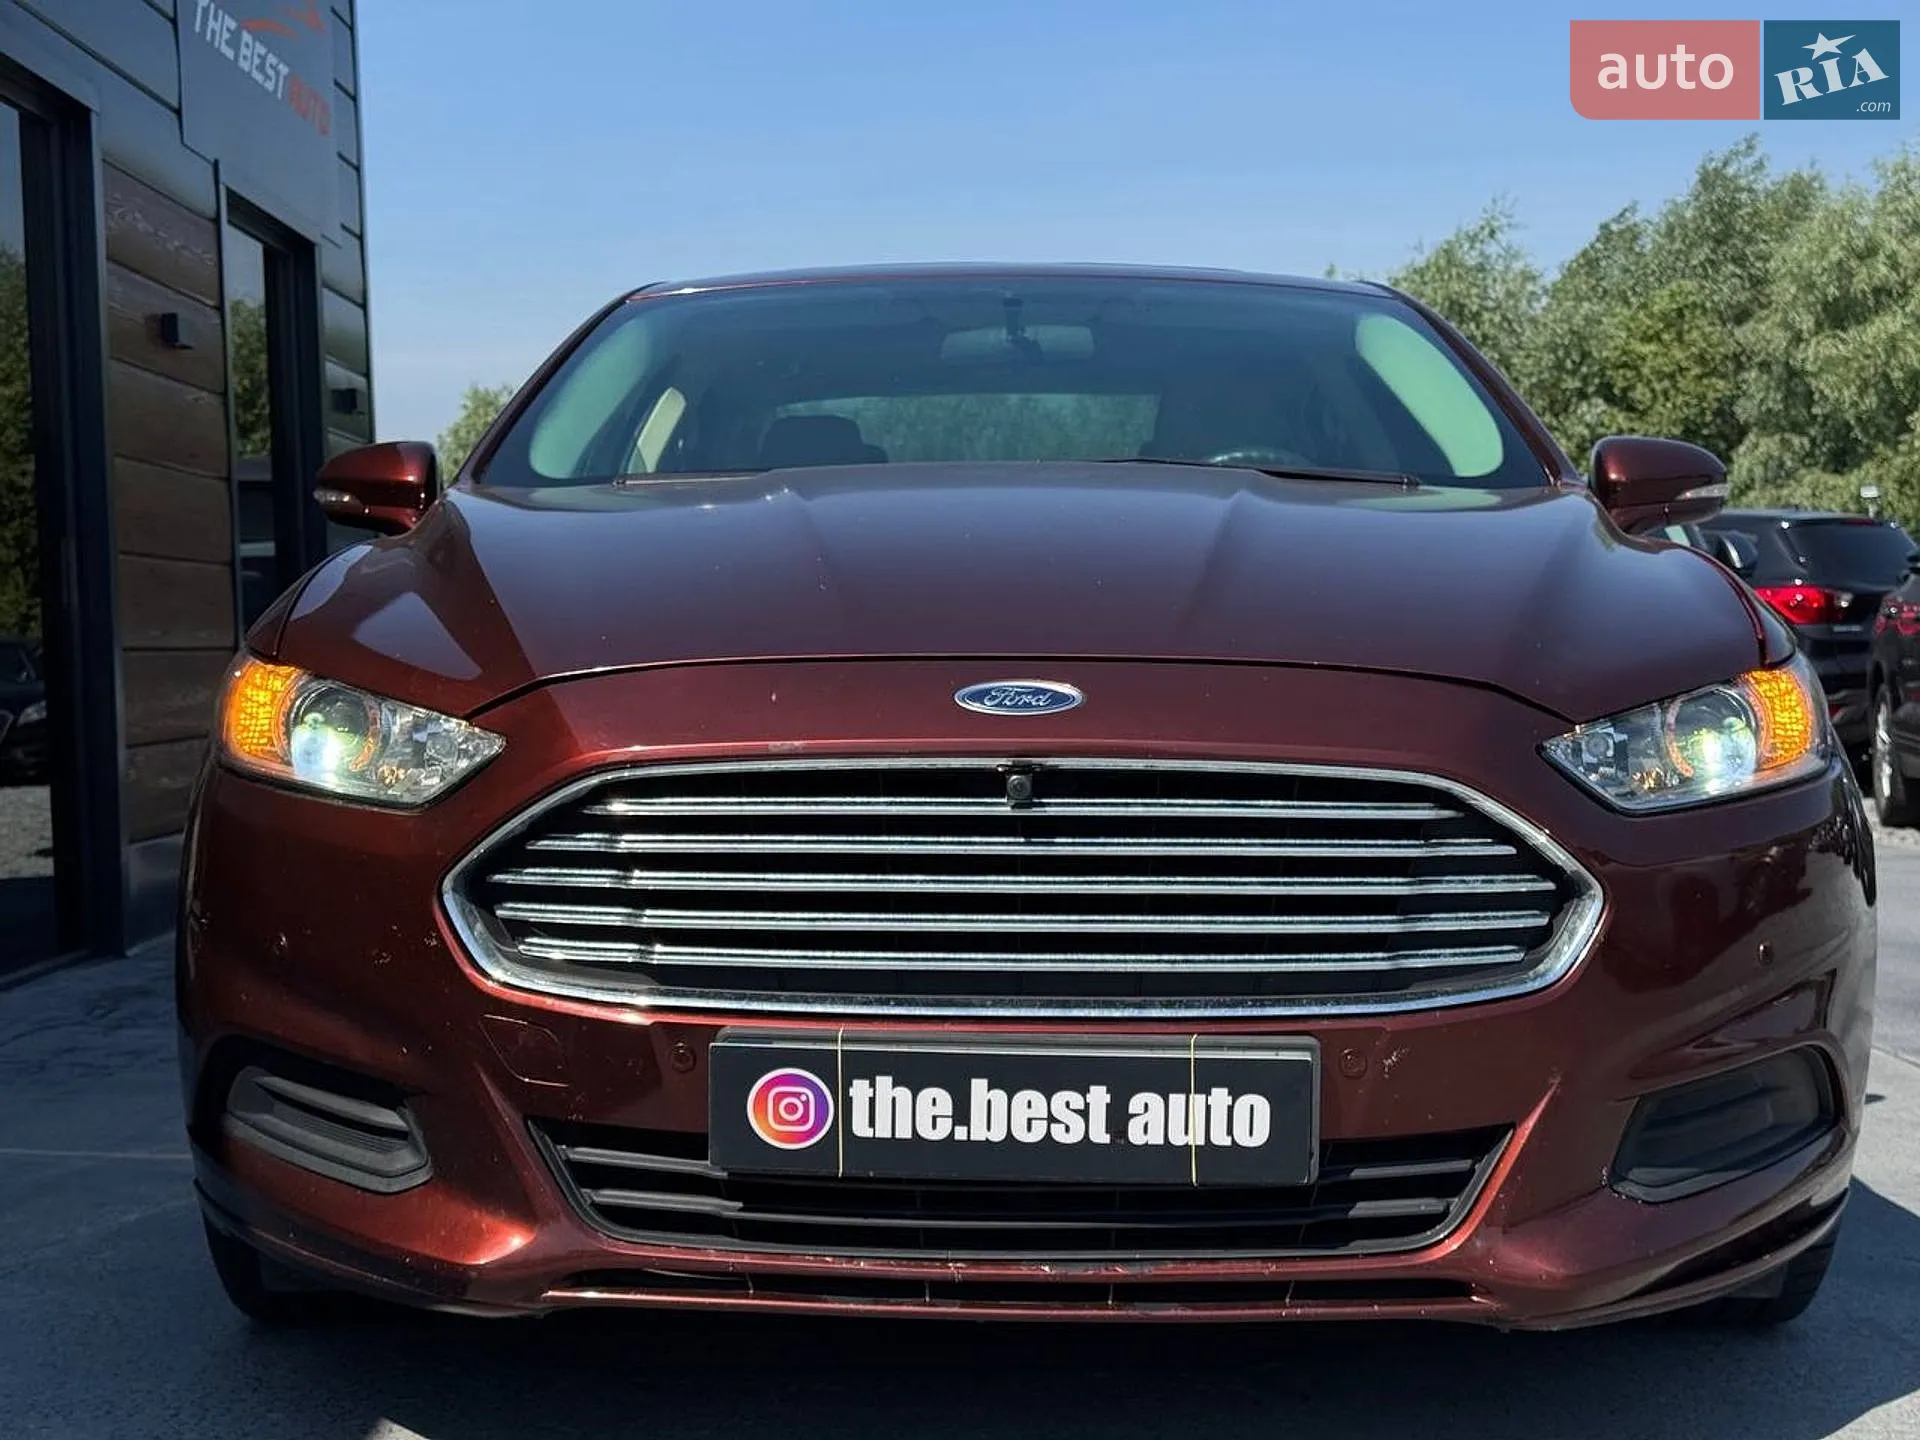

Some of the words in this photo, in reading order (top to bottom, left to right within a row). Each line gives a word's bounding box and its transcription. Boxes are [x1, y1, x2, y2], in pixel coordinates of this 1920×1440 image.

[194, 0, 239, 61] THE
[238, 29, 290, 100] BEST
[983, 686, 1055, 706] Ford
[849, 1075, 1111, 1144] the.best
[1127, 1087, 1271, 1148] auto
